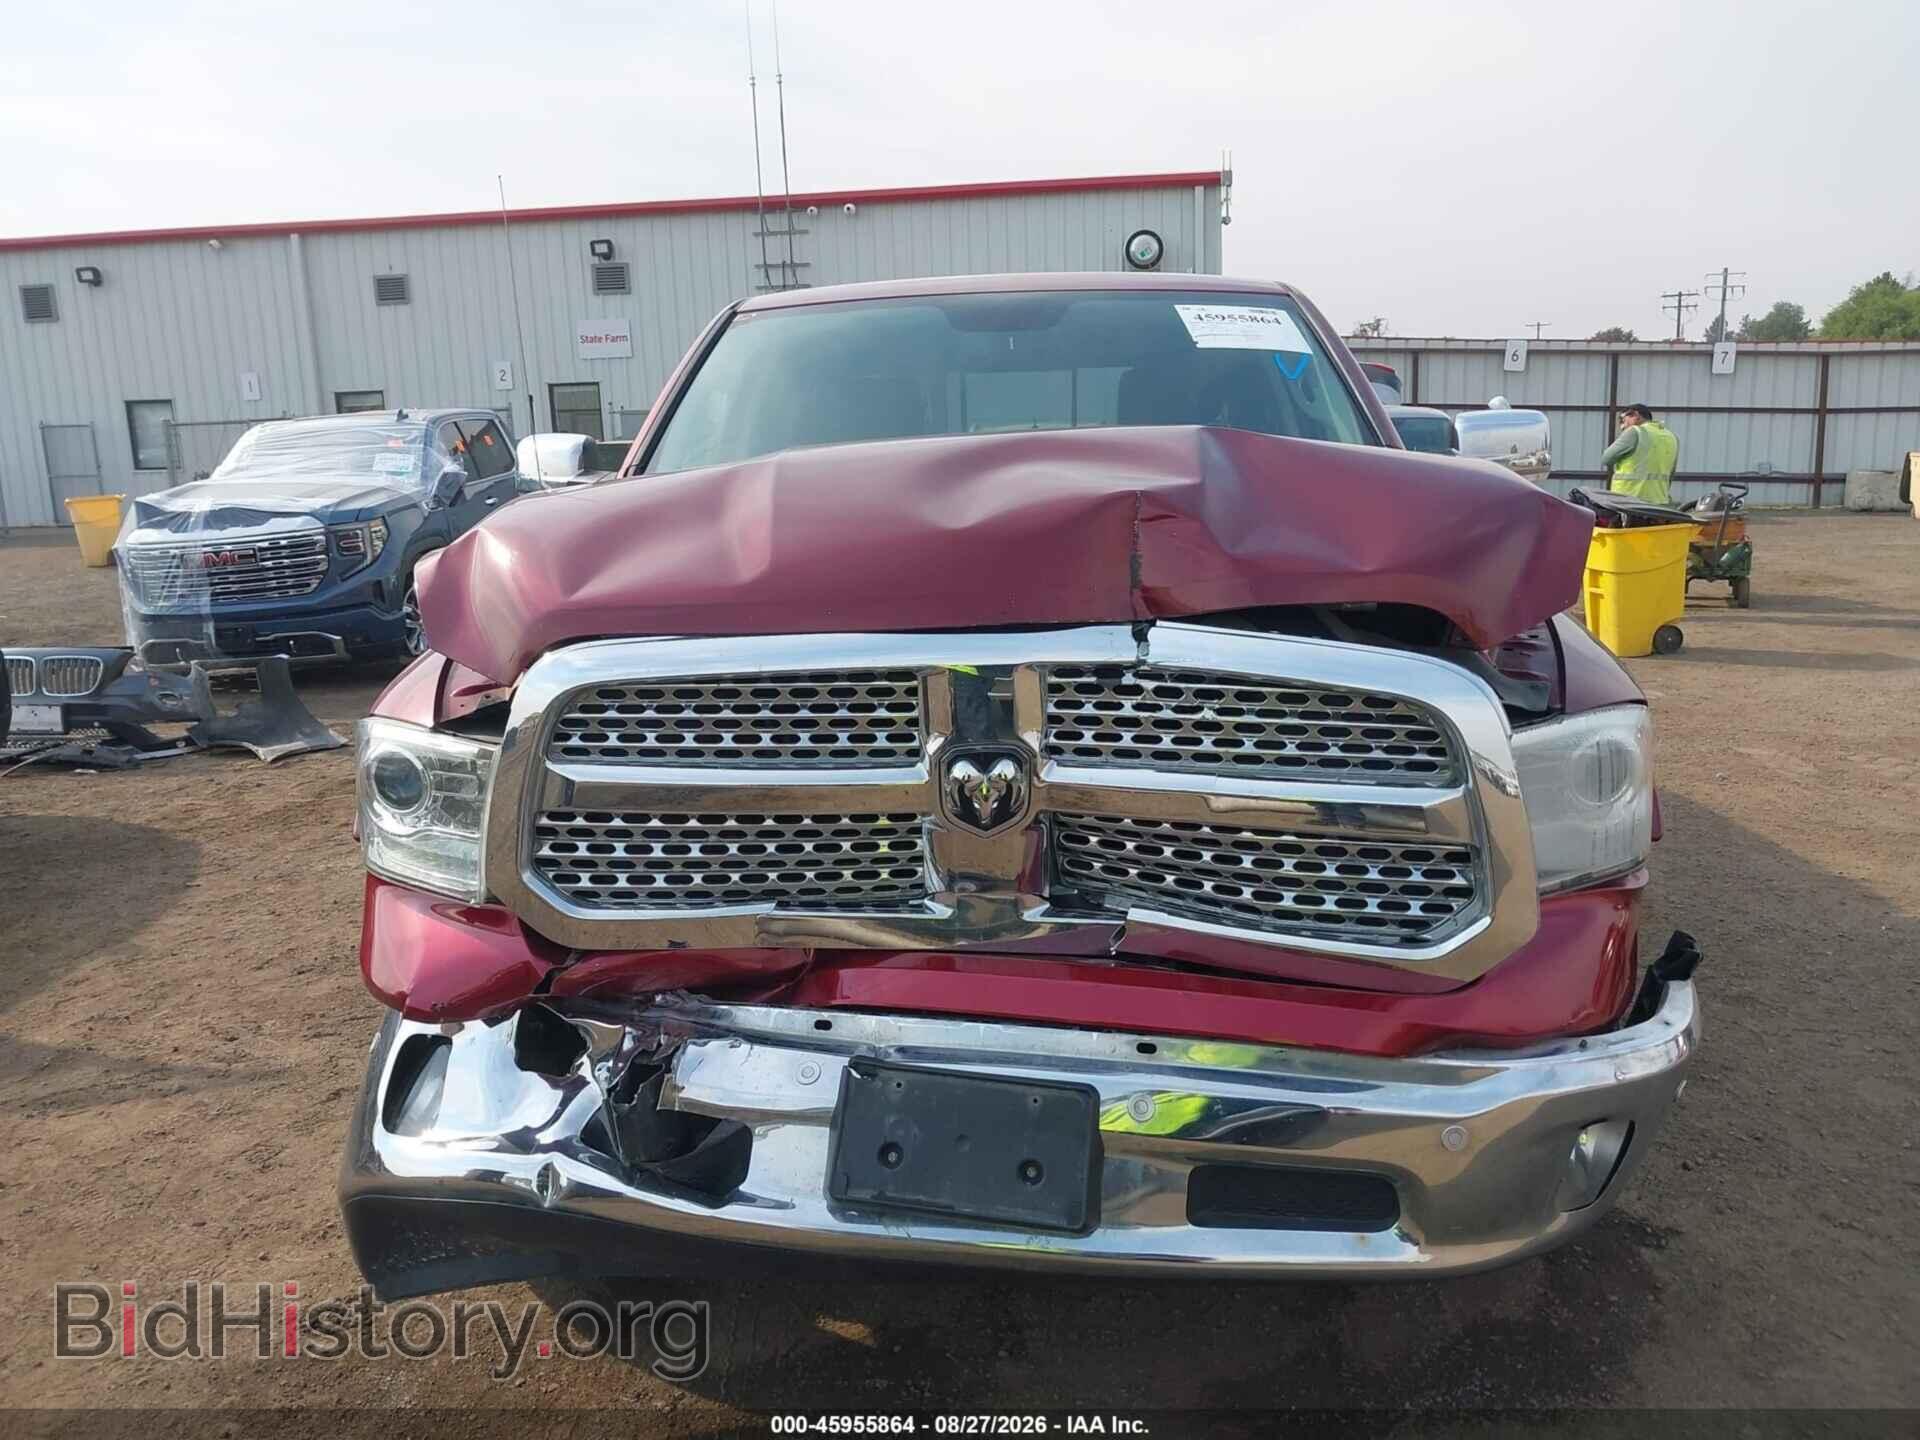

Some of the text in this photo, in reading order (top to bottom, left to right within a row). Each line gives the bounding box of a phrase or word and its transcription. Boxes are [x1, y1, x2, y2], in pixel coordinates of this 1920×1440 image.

[1193, 313, 1282, 326] 45955864
[580, 333, 629, 345] State Farm
[1511, 349, 1519, 362] 6
[1720, 351, 1729, 365] 7
[499, 369, 507, 382] 2
